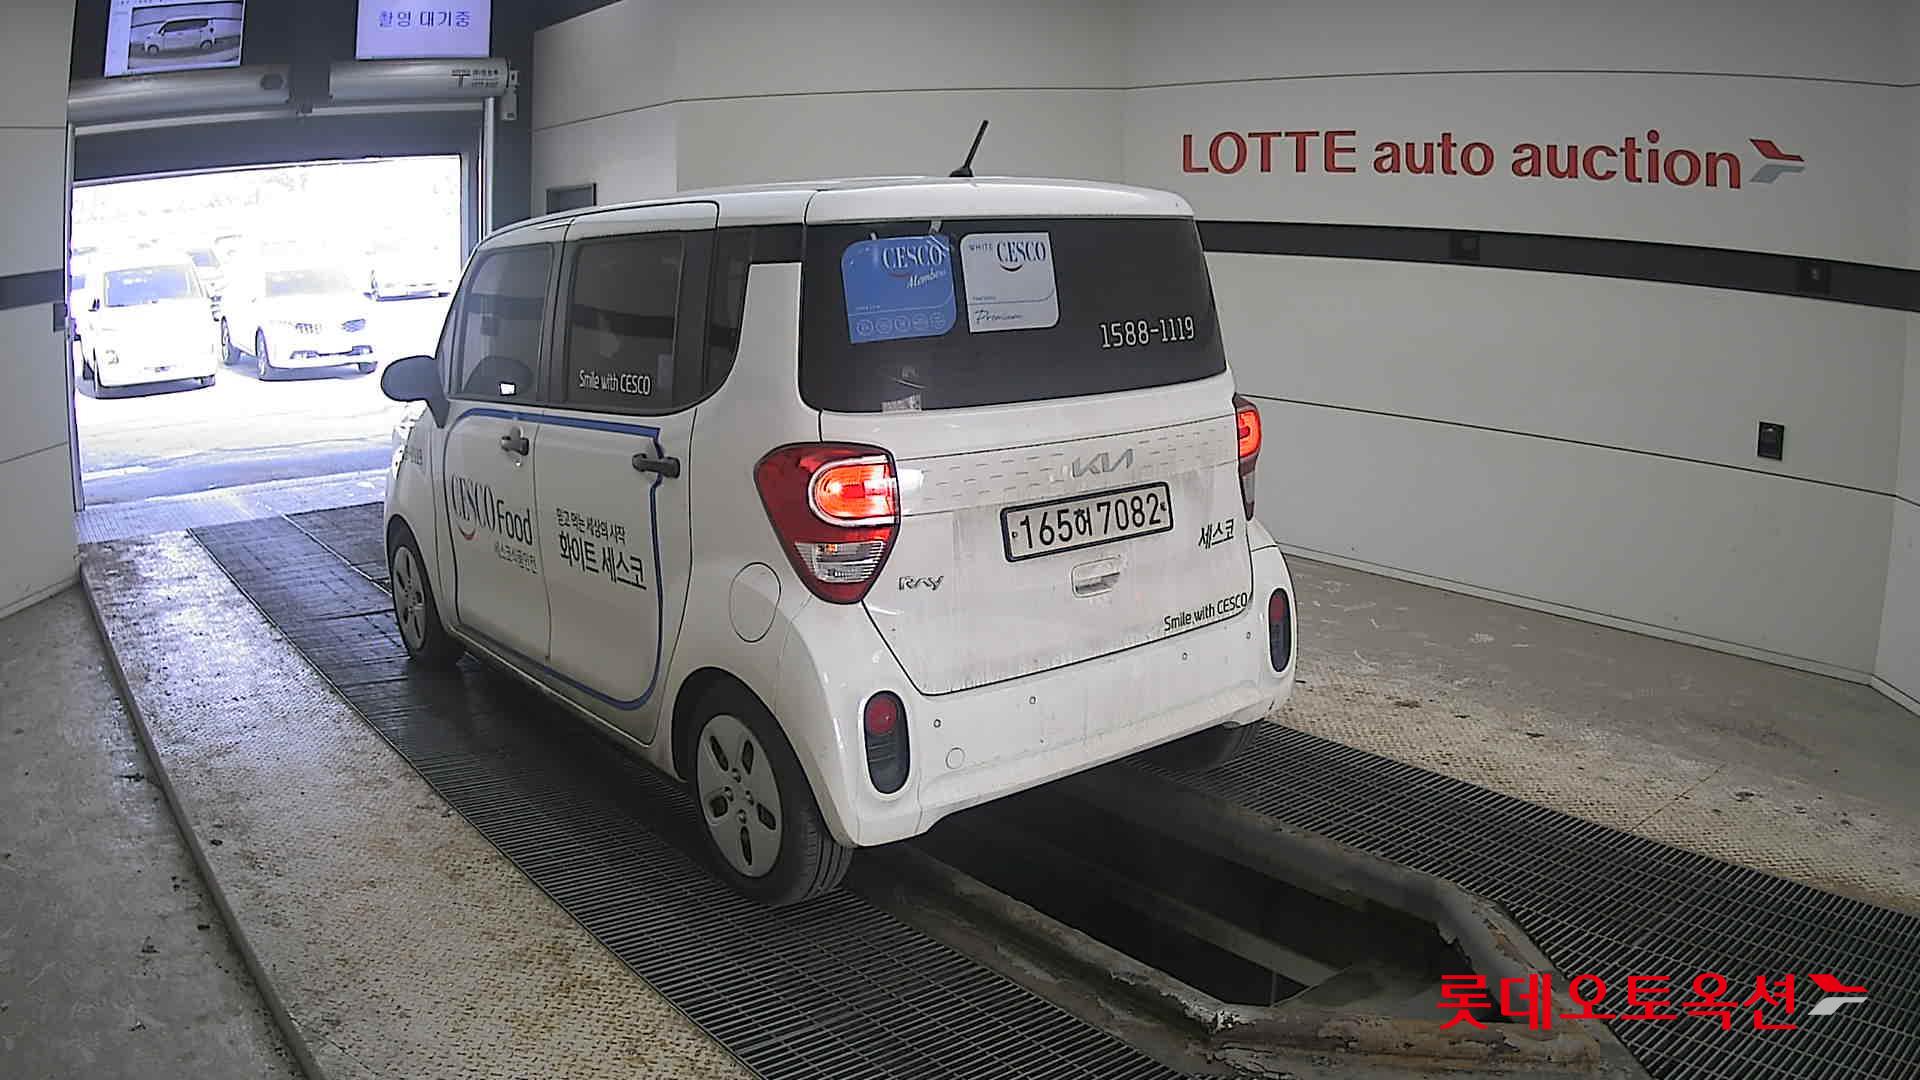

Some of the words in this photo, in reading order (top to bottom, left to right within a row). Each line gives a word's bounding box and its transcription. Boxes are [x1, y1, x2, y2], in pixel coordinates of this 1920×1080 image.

[419, 10, 471, 28] 대기중
[1182, 130, 1357, 174] LOTTE
[1373, 132, 1495, 176] auto
[1511, 129, 1742, 190] auction
[882, 243, 942, 269] CESCO
[996, 240, 1046, 263] CESCO
[1100, 316, 1194, 348] 1588-1119
[579, 369, 599, 390] Smile
[600, 371, 619, 392] with
[620, 373, 651, 395] CESCO
[496, 498, 533, 546] Food
[1019, 504, 1094, 549] 165허
[1096, 492, 1162, 535] 7082
[1197, 518, 1235, 549] 세스코
[559, 530, 600, 573] 화이트
[602, 546, 648, 591] 세스코
[1163, 610, 1193, 632] Smile
[1193, 603, 1216, 622] with
[1216, 591, 1249, 615] CESCO
